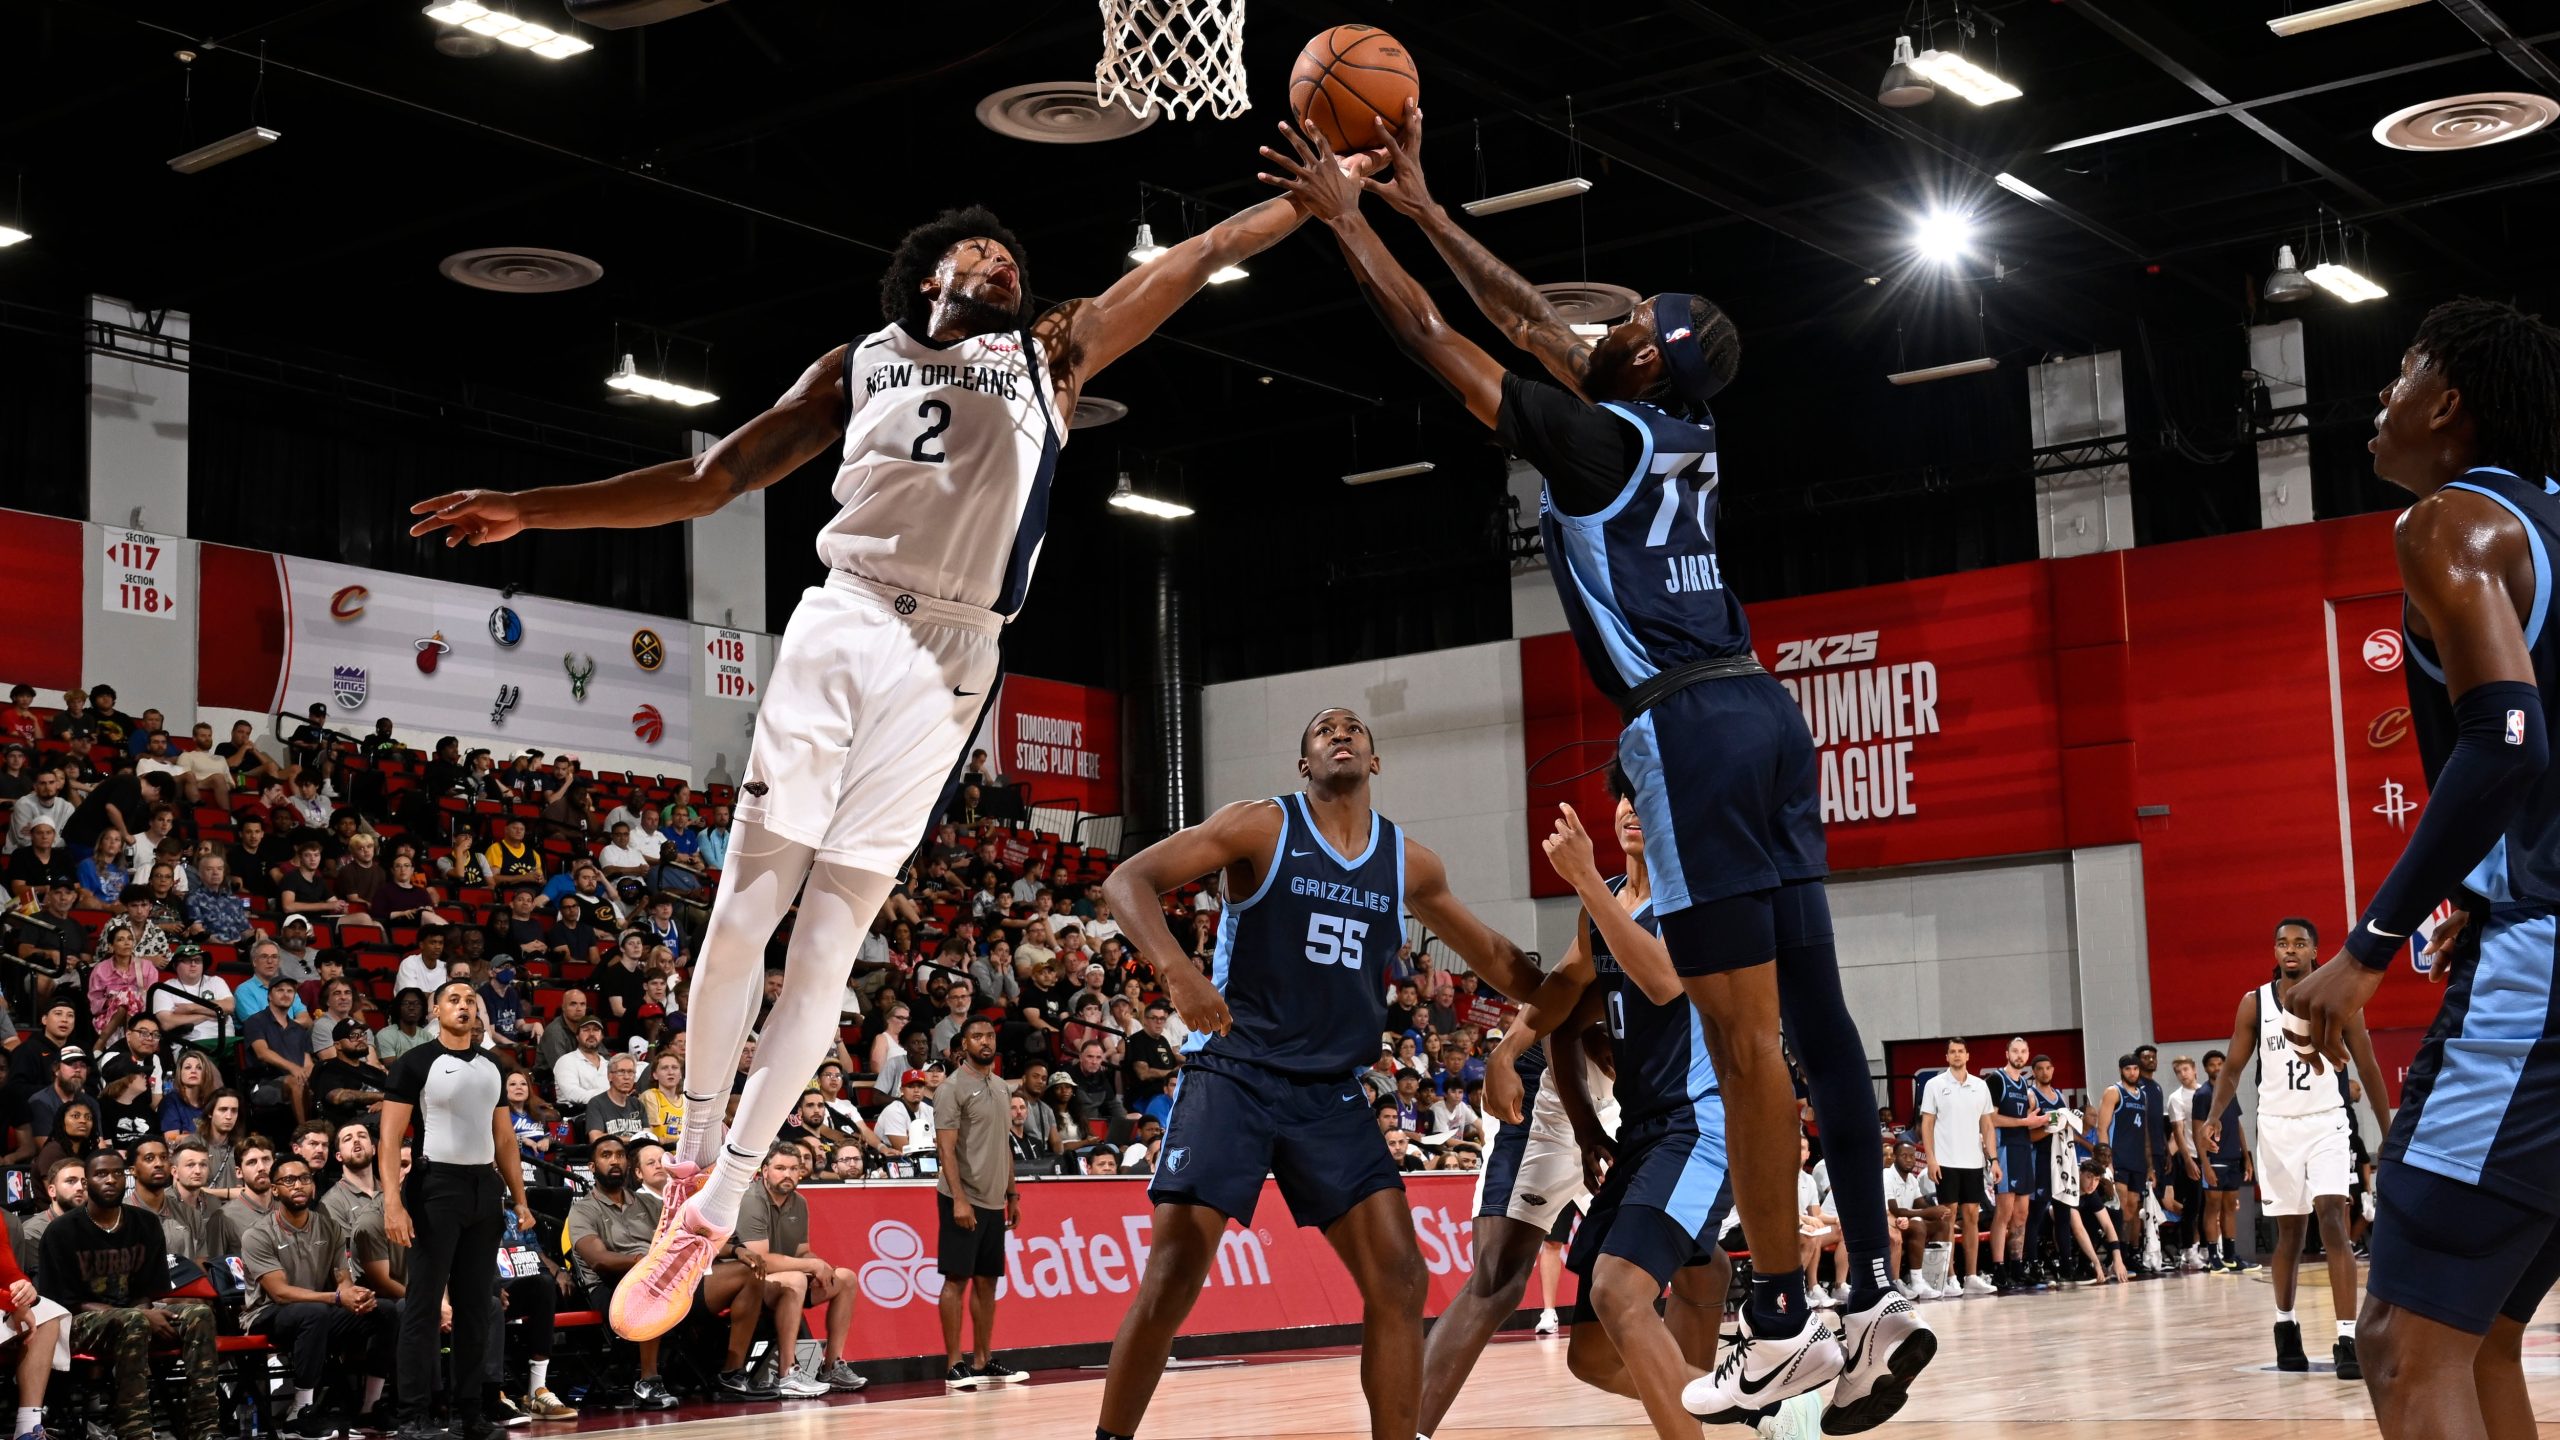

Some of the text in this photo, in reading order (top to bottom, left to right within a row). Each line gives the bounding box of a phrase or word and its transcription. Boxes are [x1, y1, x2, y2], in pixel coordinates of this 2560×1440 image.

[866, 364, 1017, 401] NEW ORLEANS
[911, 399, 951, 463] 2
[1646, 452, 1718, 547] 77
[126, 532, 155, 545] SECTION
[121, 542, 160, 571] 117
[125, 573, 154, 586] SECTION
[120, 583, 158, 613] 118
[720, 630, 740, 640] SECTION
[717, 638, 744, 662] 118
[1775, 630, 1879, 672] 2K25
[720, 664, 741, 674] SECTION
[333, 680, 365, 692] KINGS
[717, 673, 744, 696] 119
[1016, 712, 1082, 748] TOMORROW'S
[1016, 742, 1100, 780] STARS PLAY HERE
[1820, 741, 1916, 823] AGUE
[1291, 876, 1390, 913] GRIZZLIES
[1305, 912, 1369, 970] 55
[2417, 953, 2434, 967] NB
[2266, 1034, 2286, 1051] NEW
[2286, 1060, 2310, 1091] 12
[2016, 1102, 2024, 1116] 17
[2133, 1113, 2142, 1128] 4
